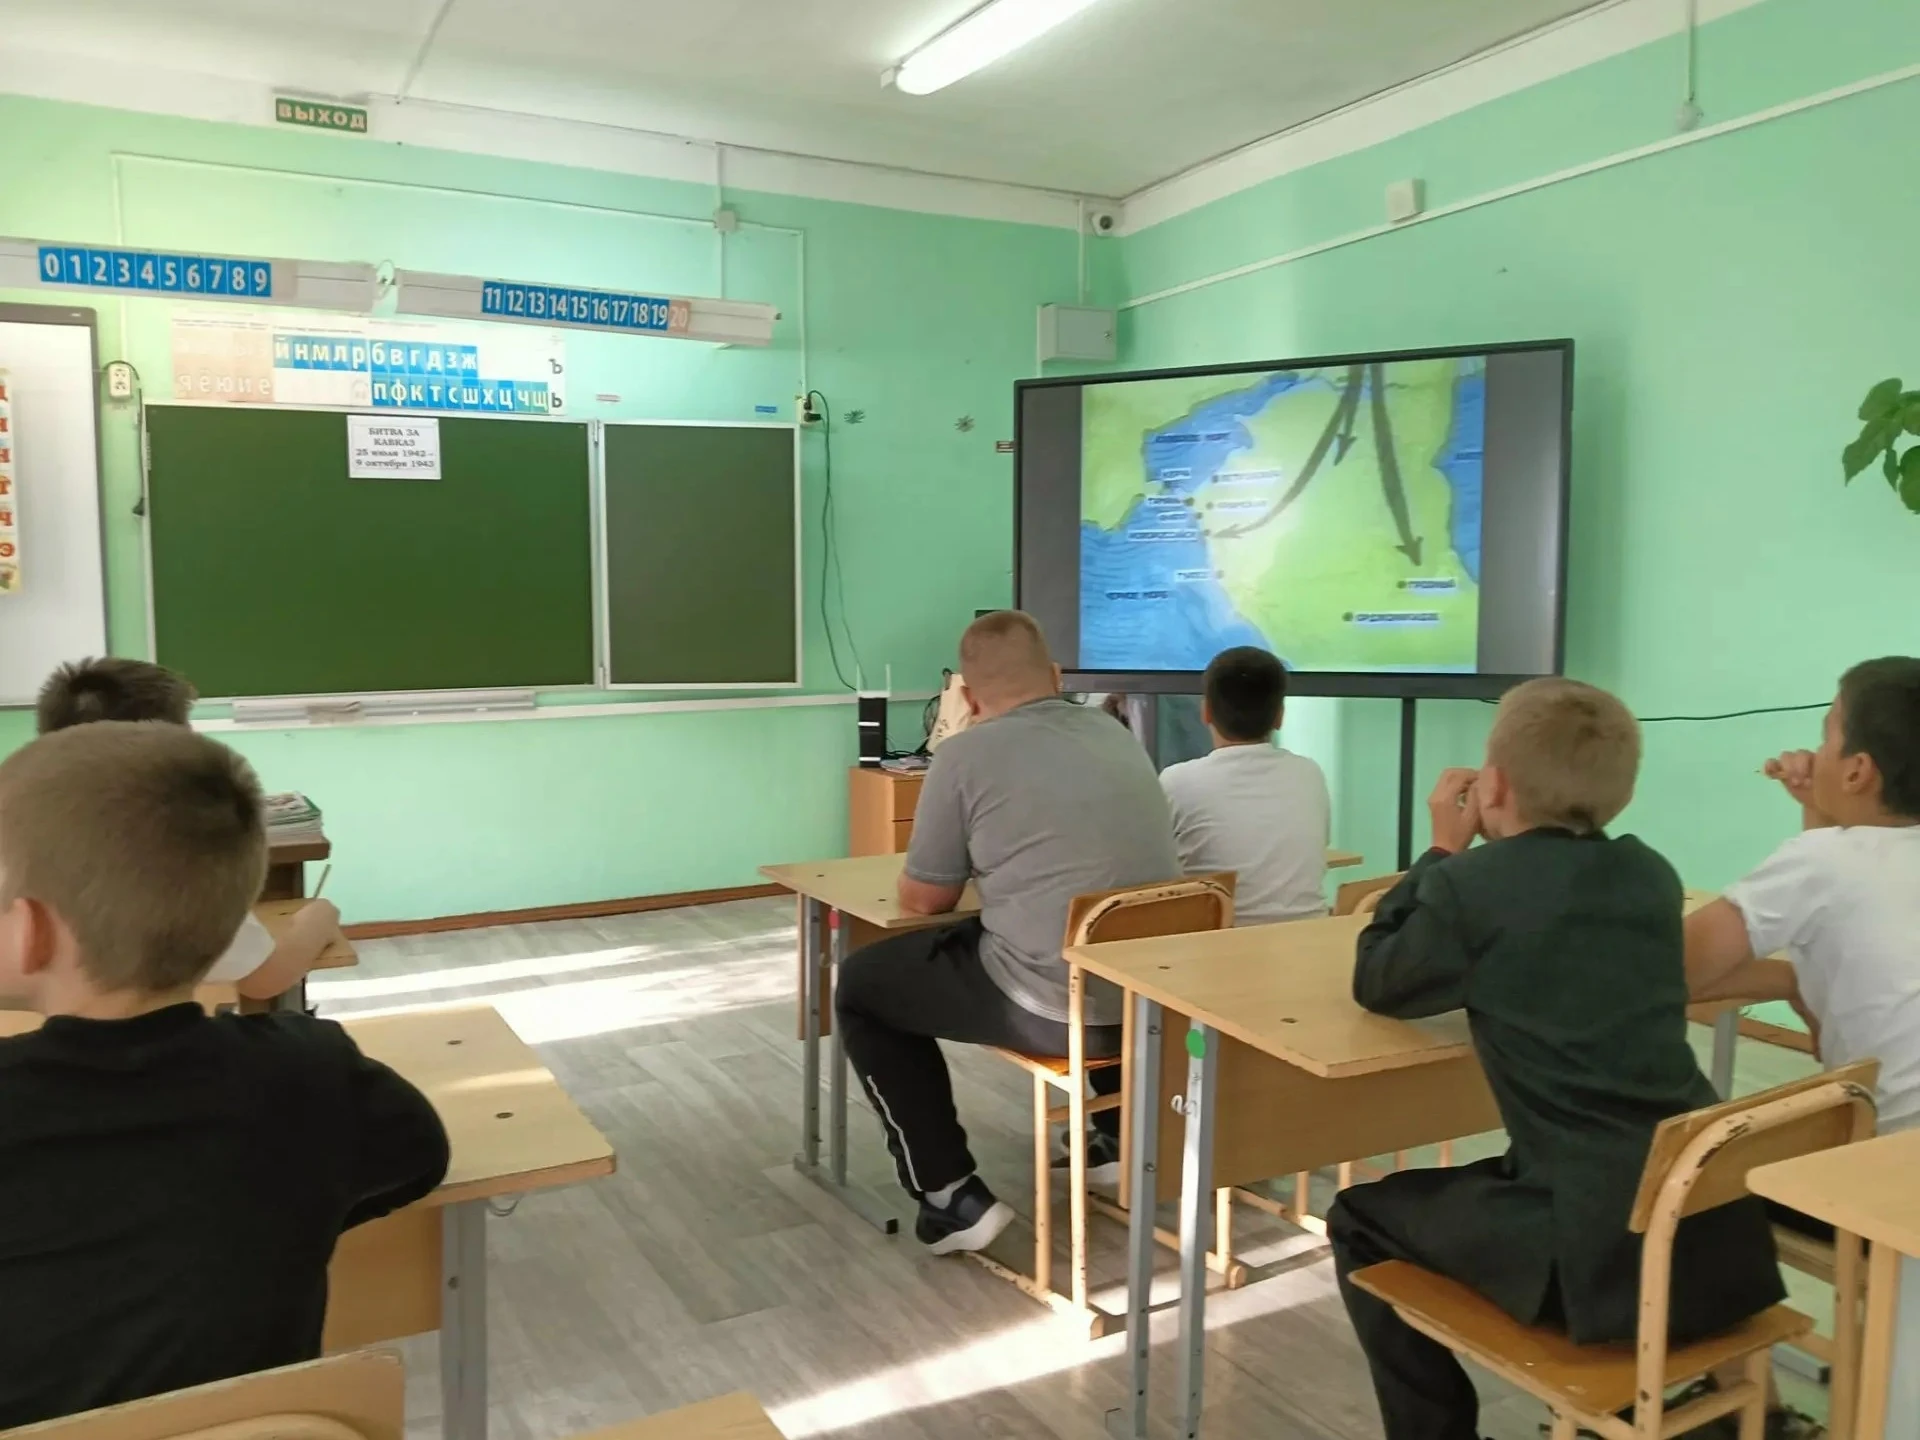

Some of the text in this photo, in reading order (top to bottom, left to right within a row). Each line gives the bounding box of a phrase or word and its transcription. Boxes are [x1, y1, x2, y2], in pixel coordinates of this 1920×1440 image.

[278, 103, 364, 129] ВЫХОД
[368, 427, 420, 437] БИТВА ЗА
[373, 438, 415, 447] КАВКАЗ
[402, 449, 426, 457] 1942
[365, 459, 407, 469] октября
